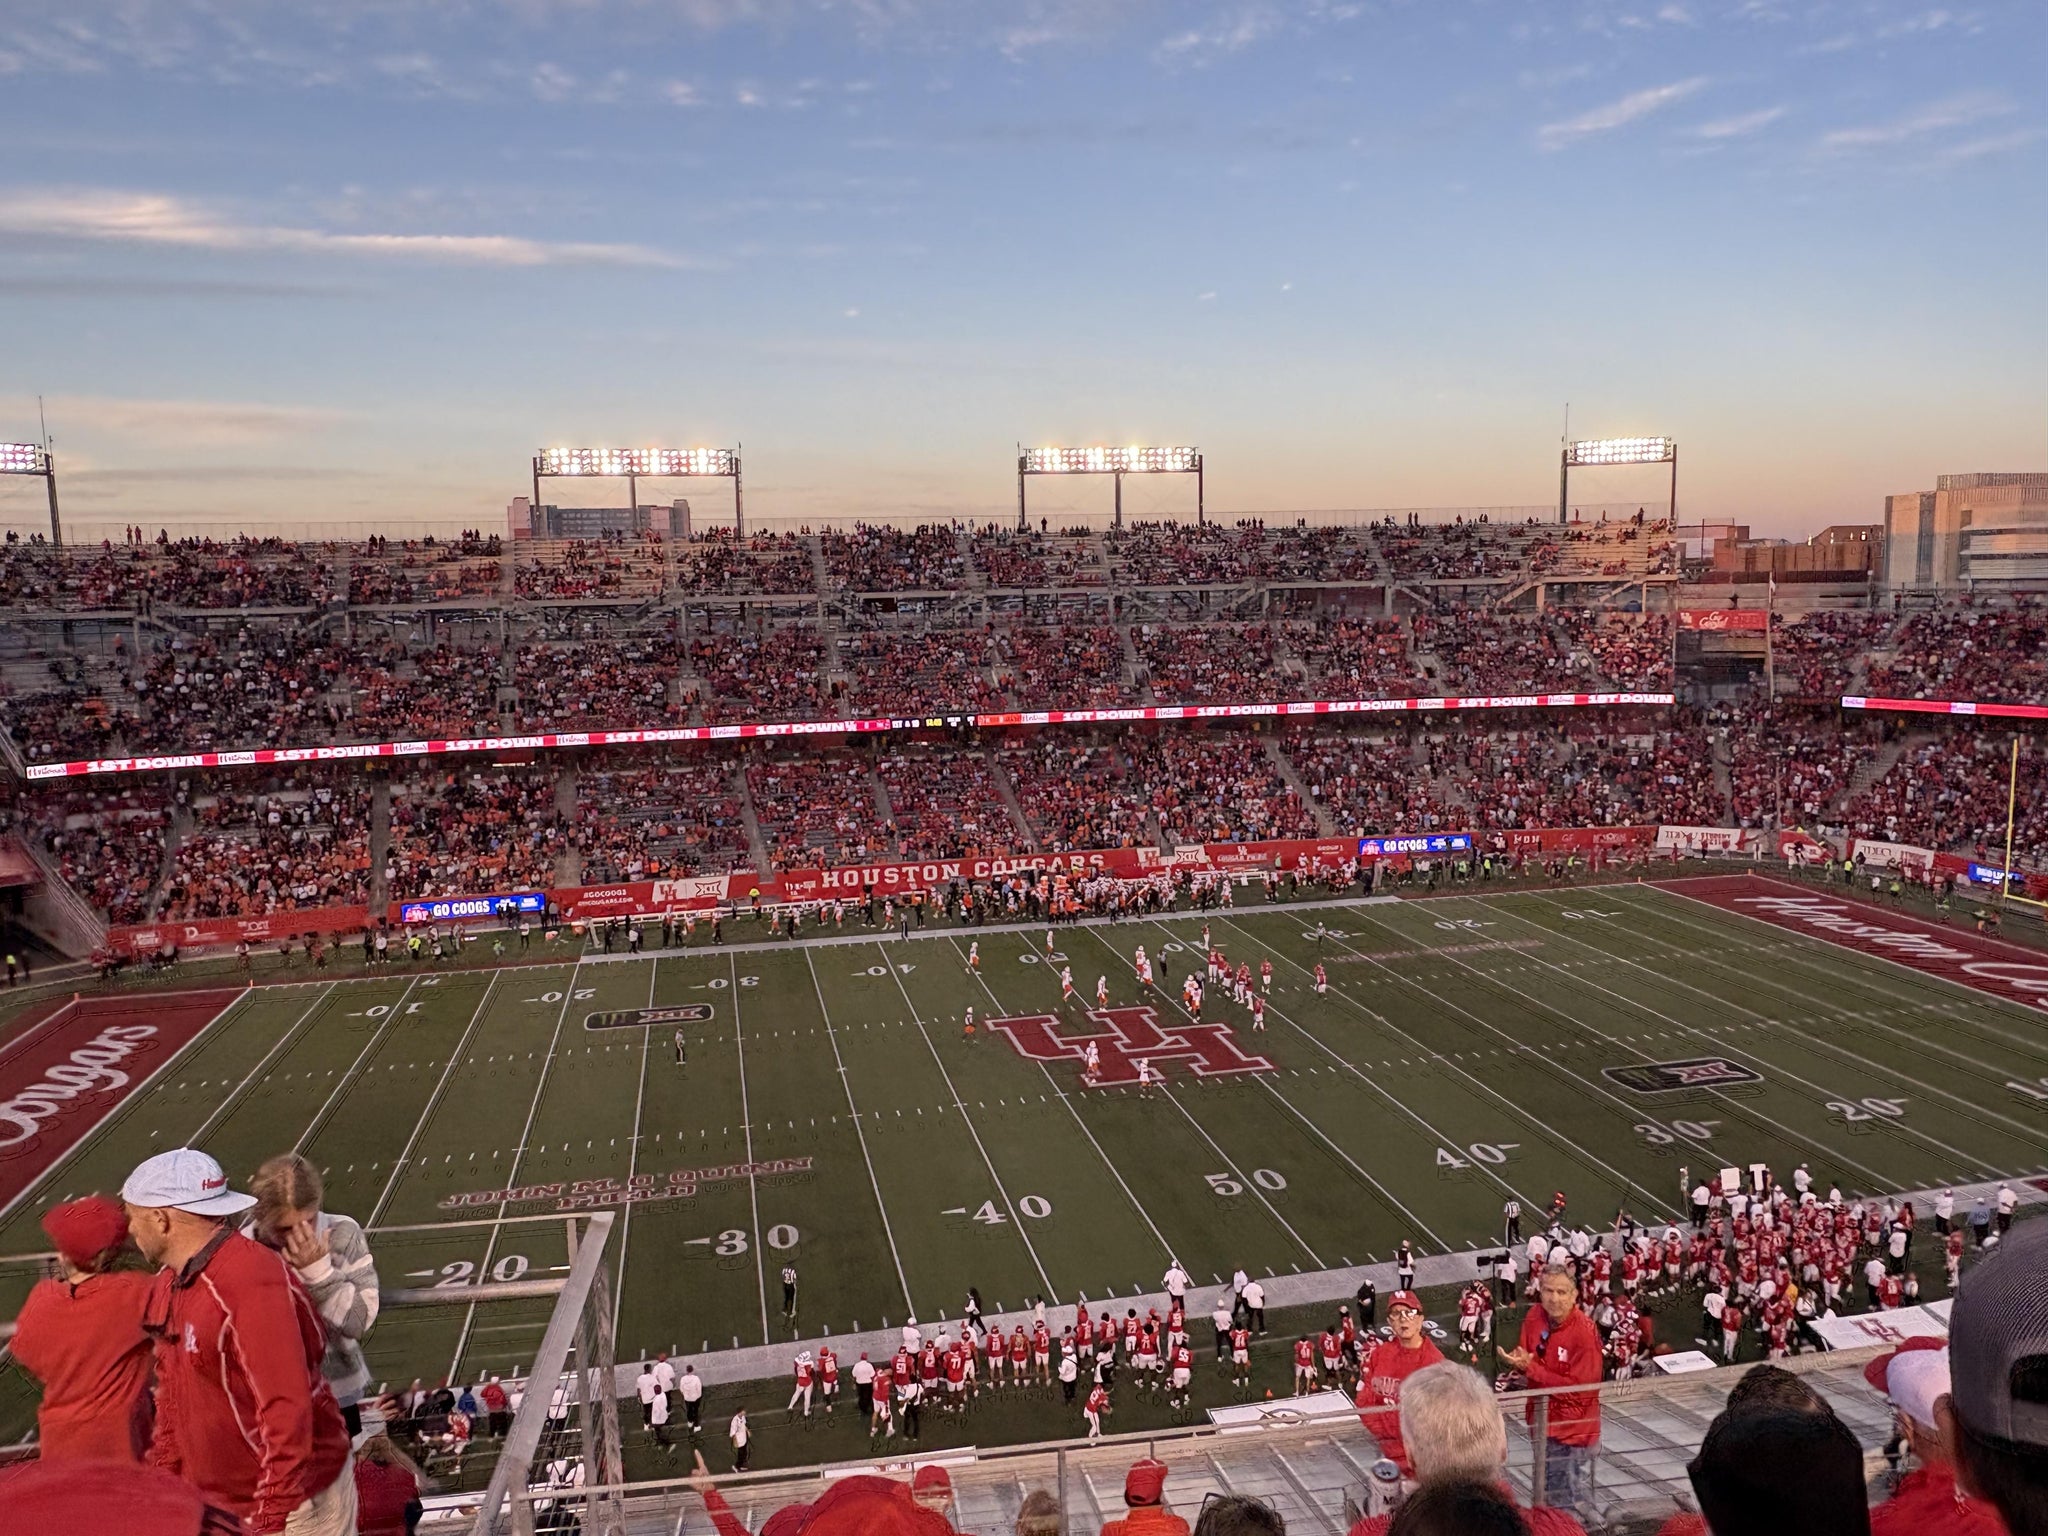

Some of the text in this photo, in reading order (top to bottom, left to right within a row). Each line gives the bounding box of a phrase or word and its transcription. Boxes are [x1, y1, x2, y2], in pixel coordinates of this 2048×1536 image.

[1328, 700, 1407, 712] 1ST DOWN
[1458, 697, 1489, 708] 1ST
[1490, 696, 1538, 707] DOWN
[1588, 693, 1618, 704] 1ST
[1620, 693, 1674, 704] DOWN
[1063, 711, 1094, 722] 1ST
[1096, 709, 1145, 720] DOWN
[1197, 706, 1228, 717] 1ST
[1230, 704, 1278, 716] DOWN
[605, 732, 641, 743] 1ST
[643, 729, 698, 741] DOWN
[755, 724, 789, 735] 1ST
[792, 721, 845, 734] DOWN
[445, 739, 482, 751] 1ST
[485, 736, 544, 749] DOWN
[274, 747, 315, 761] 1ST
[317, 744, 380, 759] DOWN
[86, 759, 134, 773] 1ST
[135, 755, 203, 770] DOWN
[1383, 840, 1396, 852] GO
[822, 854, 1105, 888] HOUSTON COUGARS
[433, 904, 450, 917] GO
[452, 900, 490, 915] COOGS
[984, 1004, 1275, 1088] UH
[1825, 1097, 1905, 1121] 20
[1634, 1119, 1713, 1144] 30
[1435, 1142, 1508, 1171] 40
[1203, 1168, 1288, 1197] 50
[438, 1183, 566, 1209] JOHN
[972, 1194, 1053, 1226] 40
[714, 1223, 800, 1258] 30
[436, 1254, 530, 1289] 20
